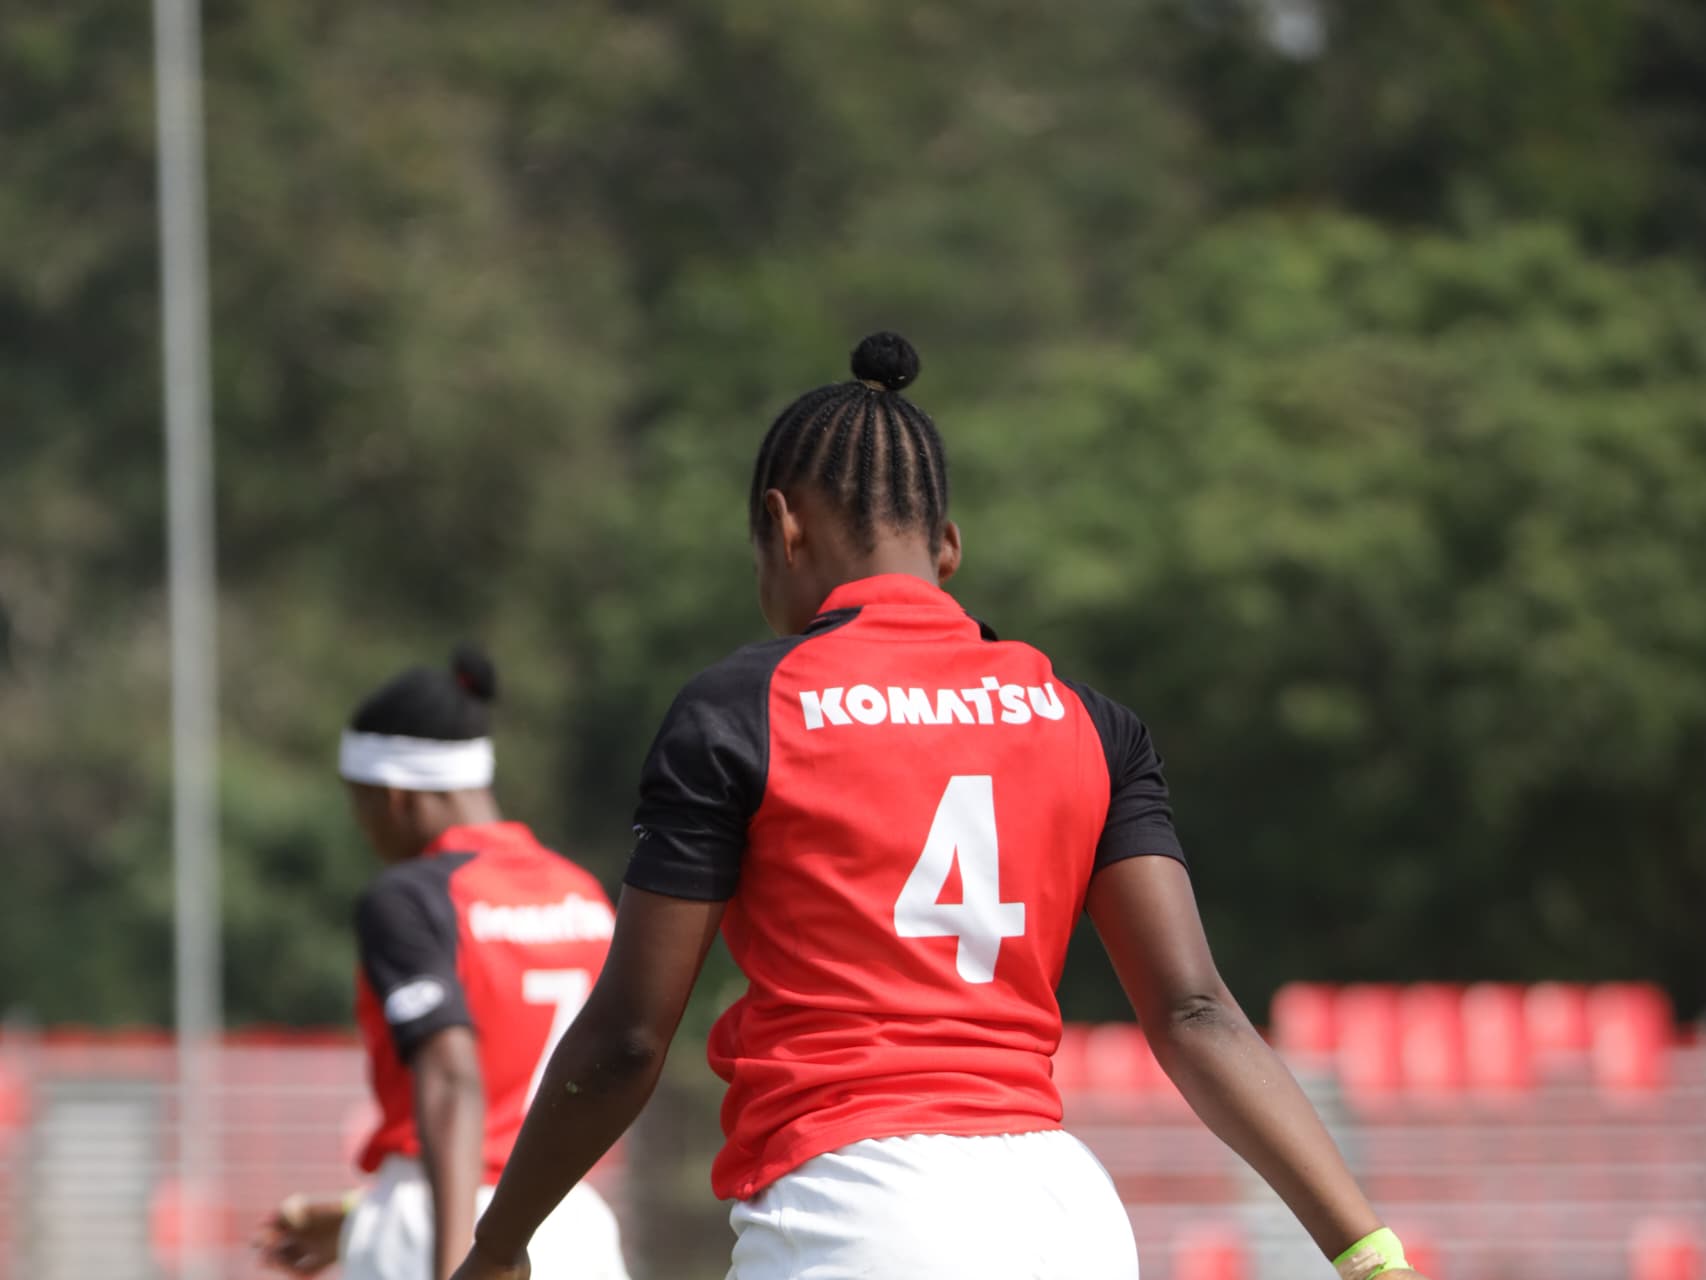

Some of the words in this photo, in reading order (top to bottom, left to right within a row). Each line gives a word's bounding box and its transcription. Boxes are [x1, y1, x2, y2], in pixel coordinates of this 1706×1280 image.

[799, 676, 1065, 730] KOMATSU
[894, 775, 1025, 984] 4
[522, 969, 591, 1116] 7
